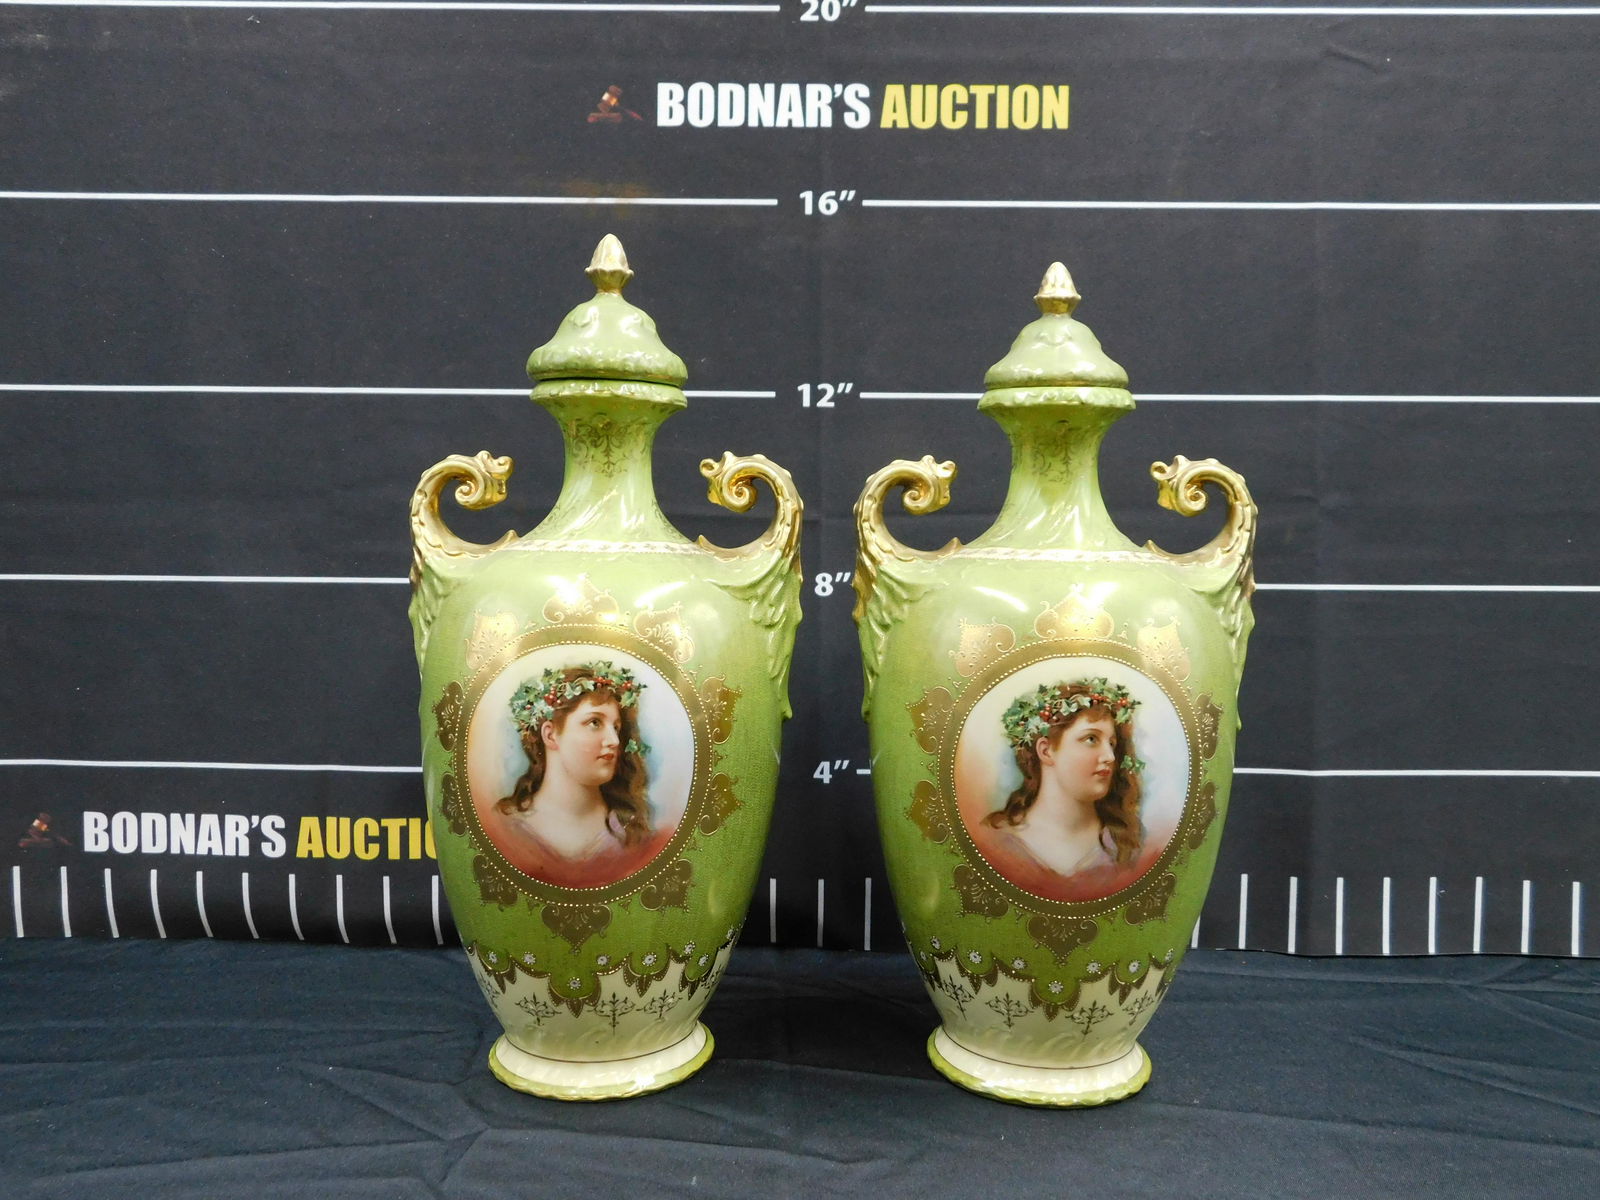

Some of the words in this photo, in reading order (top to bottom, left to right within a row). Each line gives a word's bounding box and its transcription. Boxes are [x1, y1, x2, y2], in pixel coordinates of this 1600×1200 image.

[656, 81, 872, 130] BODNAR'S
[879, 83, 1070, 131] AUCTION
[83, 810, 287, 859] BODNAR'S
